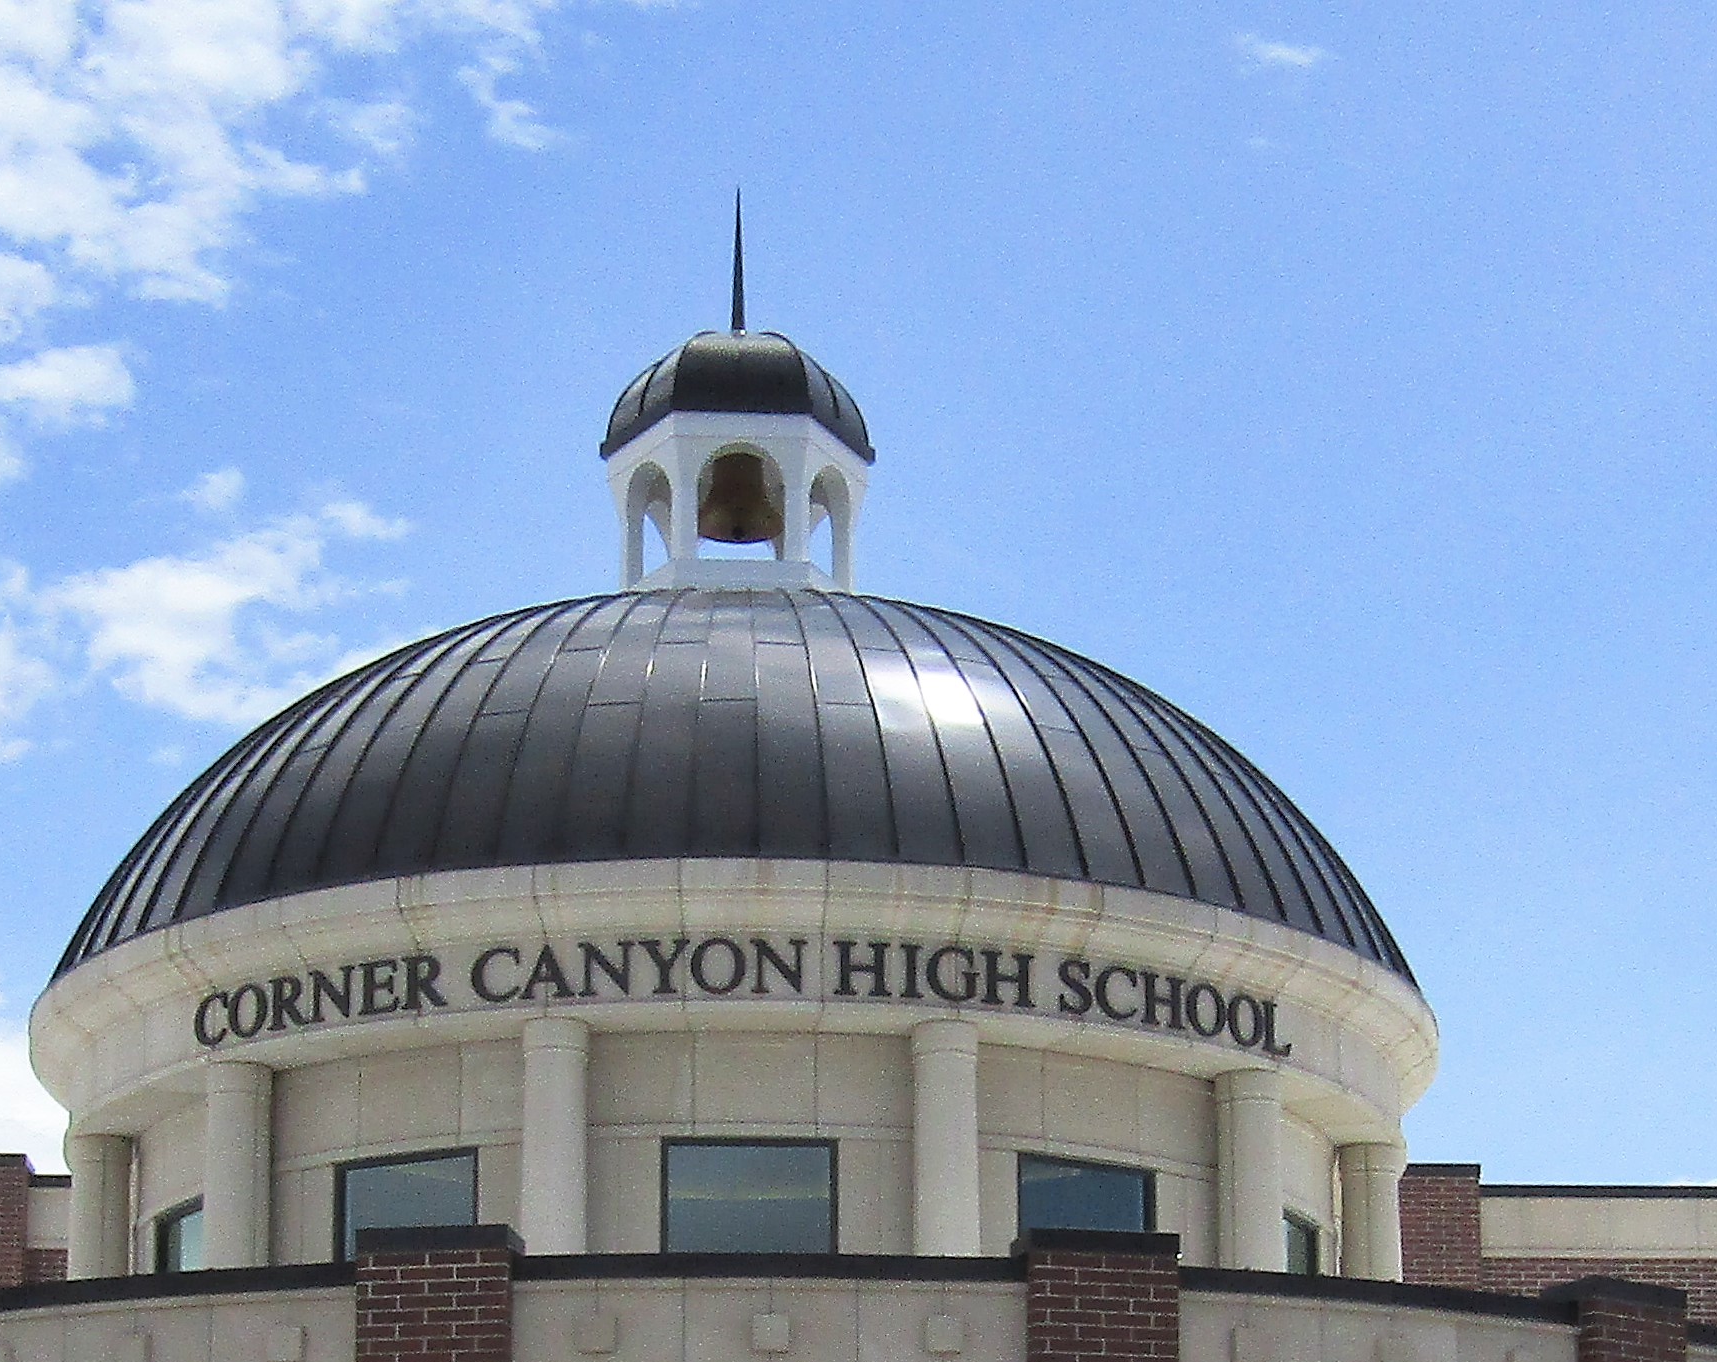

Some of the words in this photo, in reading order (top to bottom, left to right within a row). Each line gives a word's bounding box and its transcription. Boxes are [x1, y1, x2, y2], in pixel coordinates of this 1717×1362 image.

[193, 954, 448, 1049] CORNER
[470, 938, 808, 1002] CANYON
[833, 941, 1035, 1008] HIGH
[1057, 959, 1293, 1057] SCHOOL
